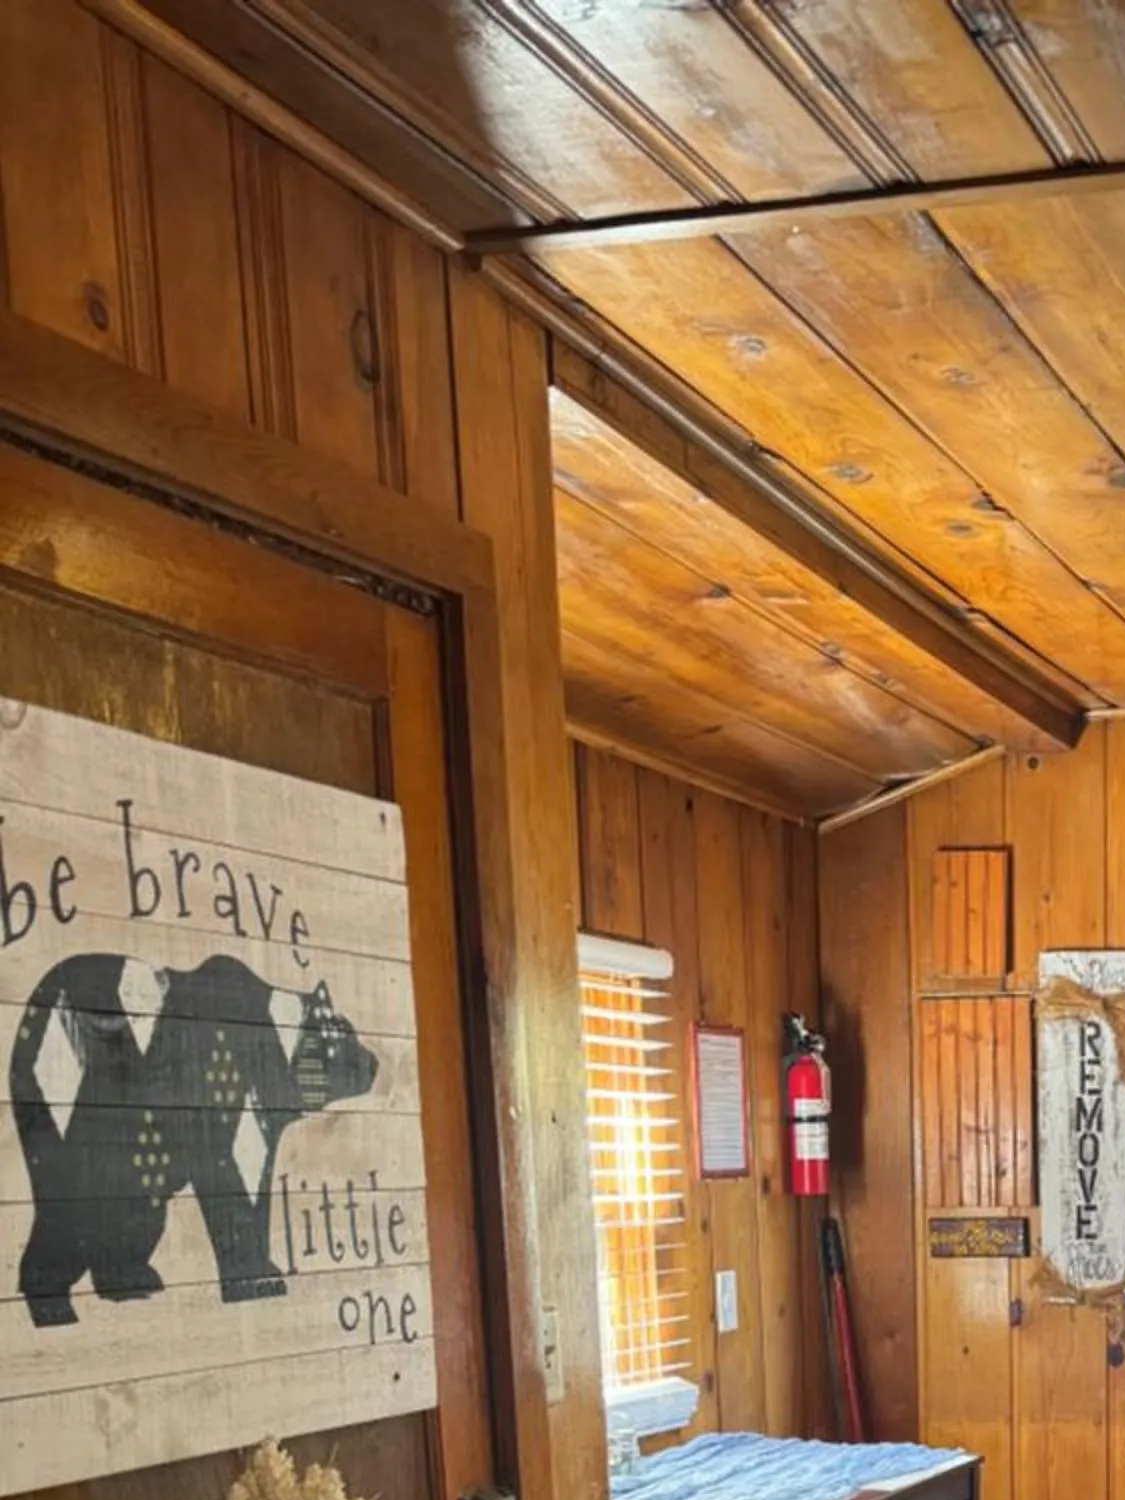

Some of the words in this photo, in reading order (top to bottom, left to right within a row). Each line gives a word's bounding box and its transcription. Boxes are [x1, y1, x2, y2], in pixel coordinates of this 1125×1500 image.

[0, 816, 77, 947] be
[116, 799, 310, 968] brave
[1075, 1020, 1103, 1240] REMOVE
[279, 1169, 407, 1276] little
[337, 1290, 418, 1346] one
